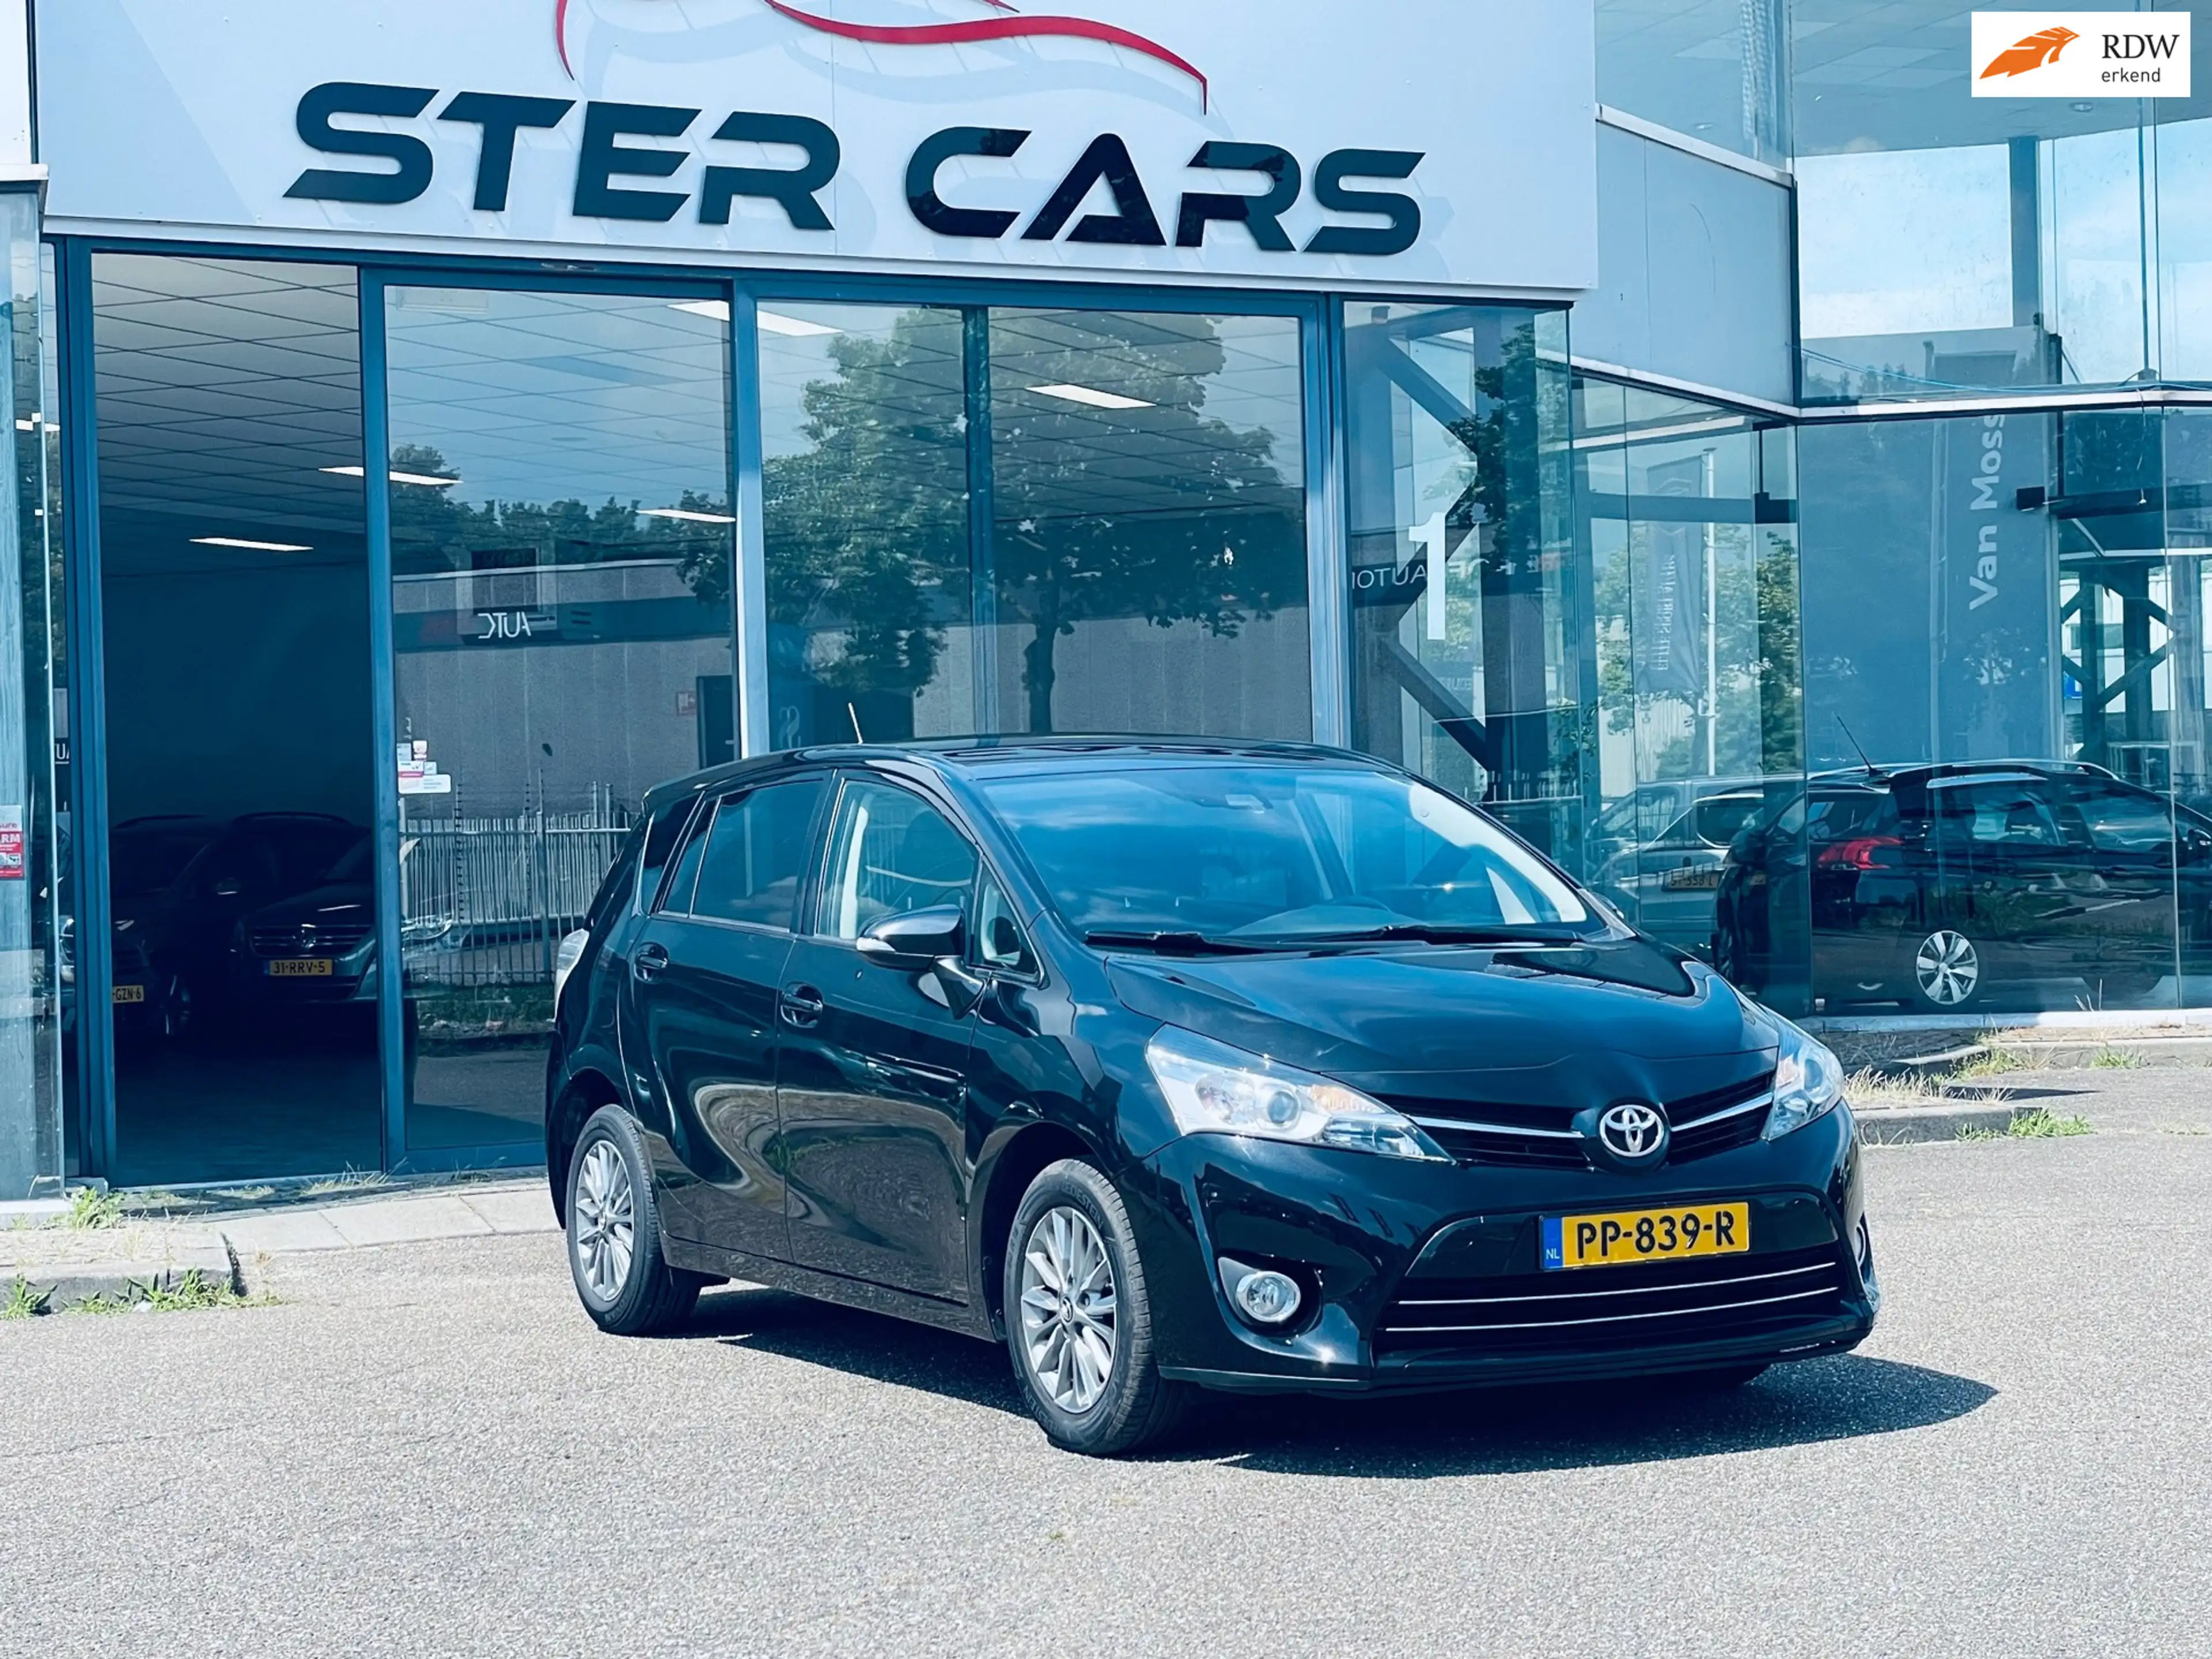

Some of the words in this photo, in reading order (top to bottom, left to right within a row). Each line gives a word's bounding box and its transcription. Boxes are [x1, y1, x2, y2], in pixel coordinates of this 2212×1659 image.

[282, 81, 840, 230] STER
[905, 126, 1426, 256] CARS
[1409, 512, 1445, 640] 1
[1969, 525, 1998, 611] Van
[0, 834, 21, 843] RM
[274, 961, 326, 974] 31-RRV-5
[113, 987, 142, 1001] -GZN-6
[1546, 1248, 1560, 1260] NL
[1577, 1211, 1735, 1259] PP-839-R
